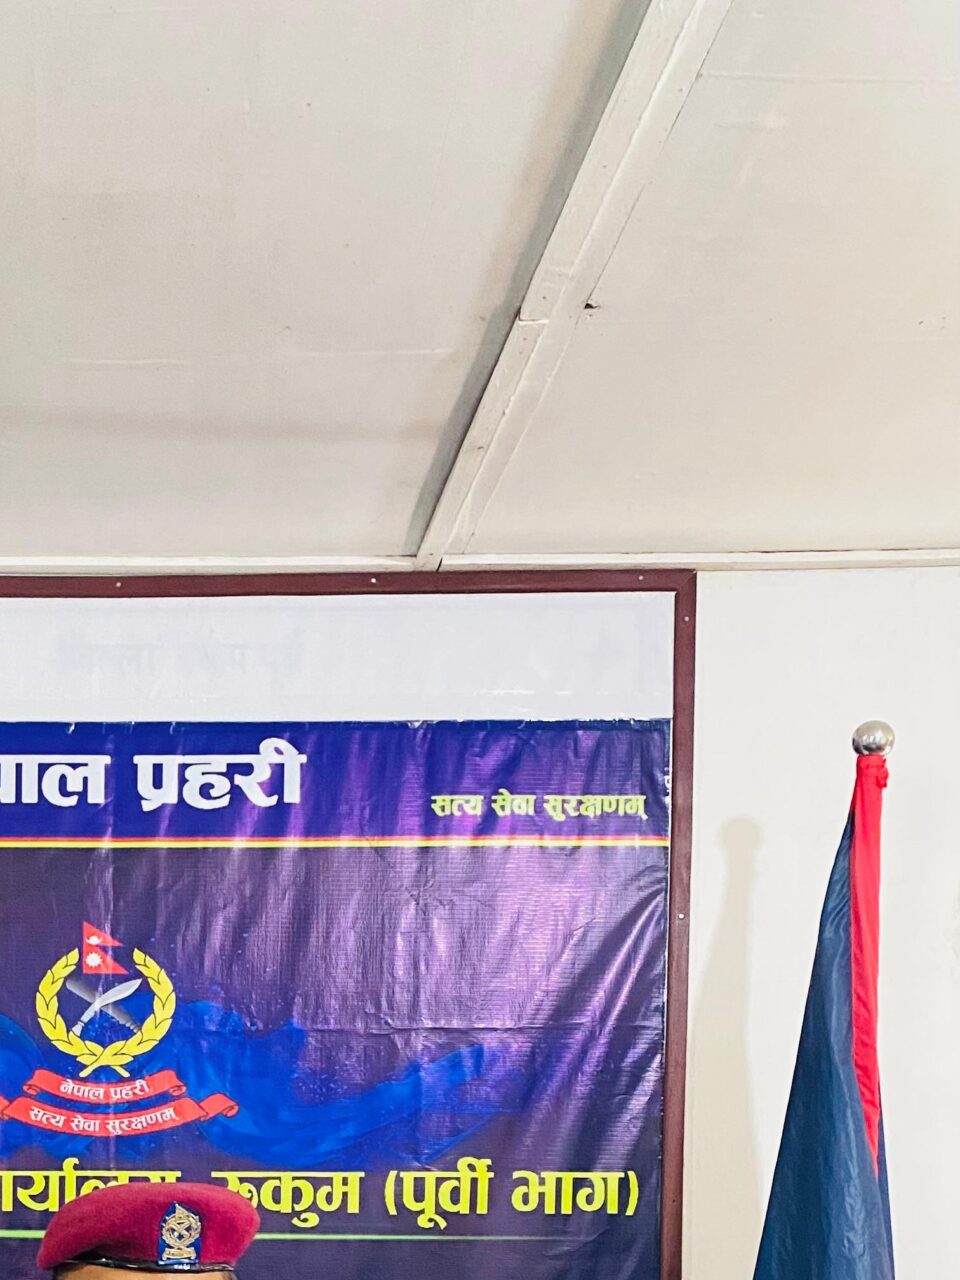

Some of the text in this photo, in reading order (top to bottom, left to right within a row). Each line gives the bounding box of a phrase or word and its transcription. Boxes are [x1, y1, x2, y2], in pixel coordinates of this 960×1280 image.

[133, 737, 307, 812] प्रहरी
[431, 788, 648, 821] सत्य सेवा सुरक्षणम्
[59, 1079, 150, 1100] नेपाल प्रहरी
[29, 1105, 179, 1135] सत्य सेवा सुरक्षणम्
[384, 1156, 494, 1229] (पूर्वी
[511, 1169, 639, 1216] भाग)
